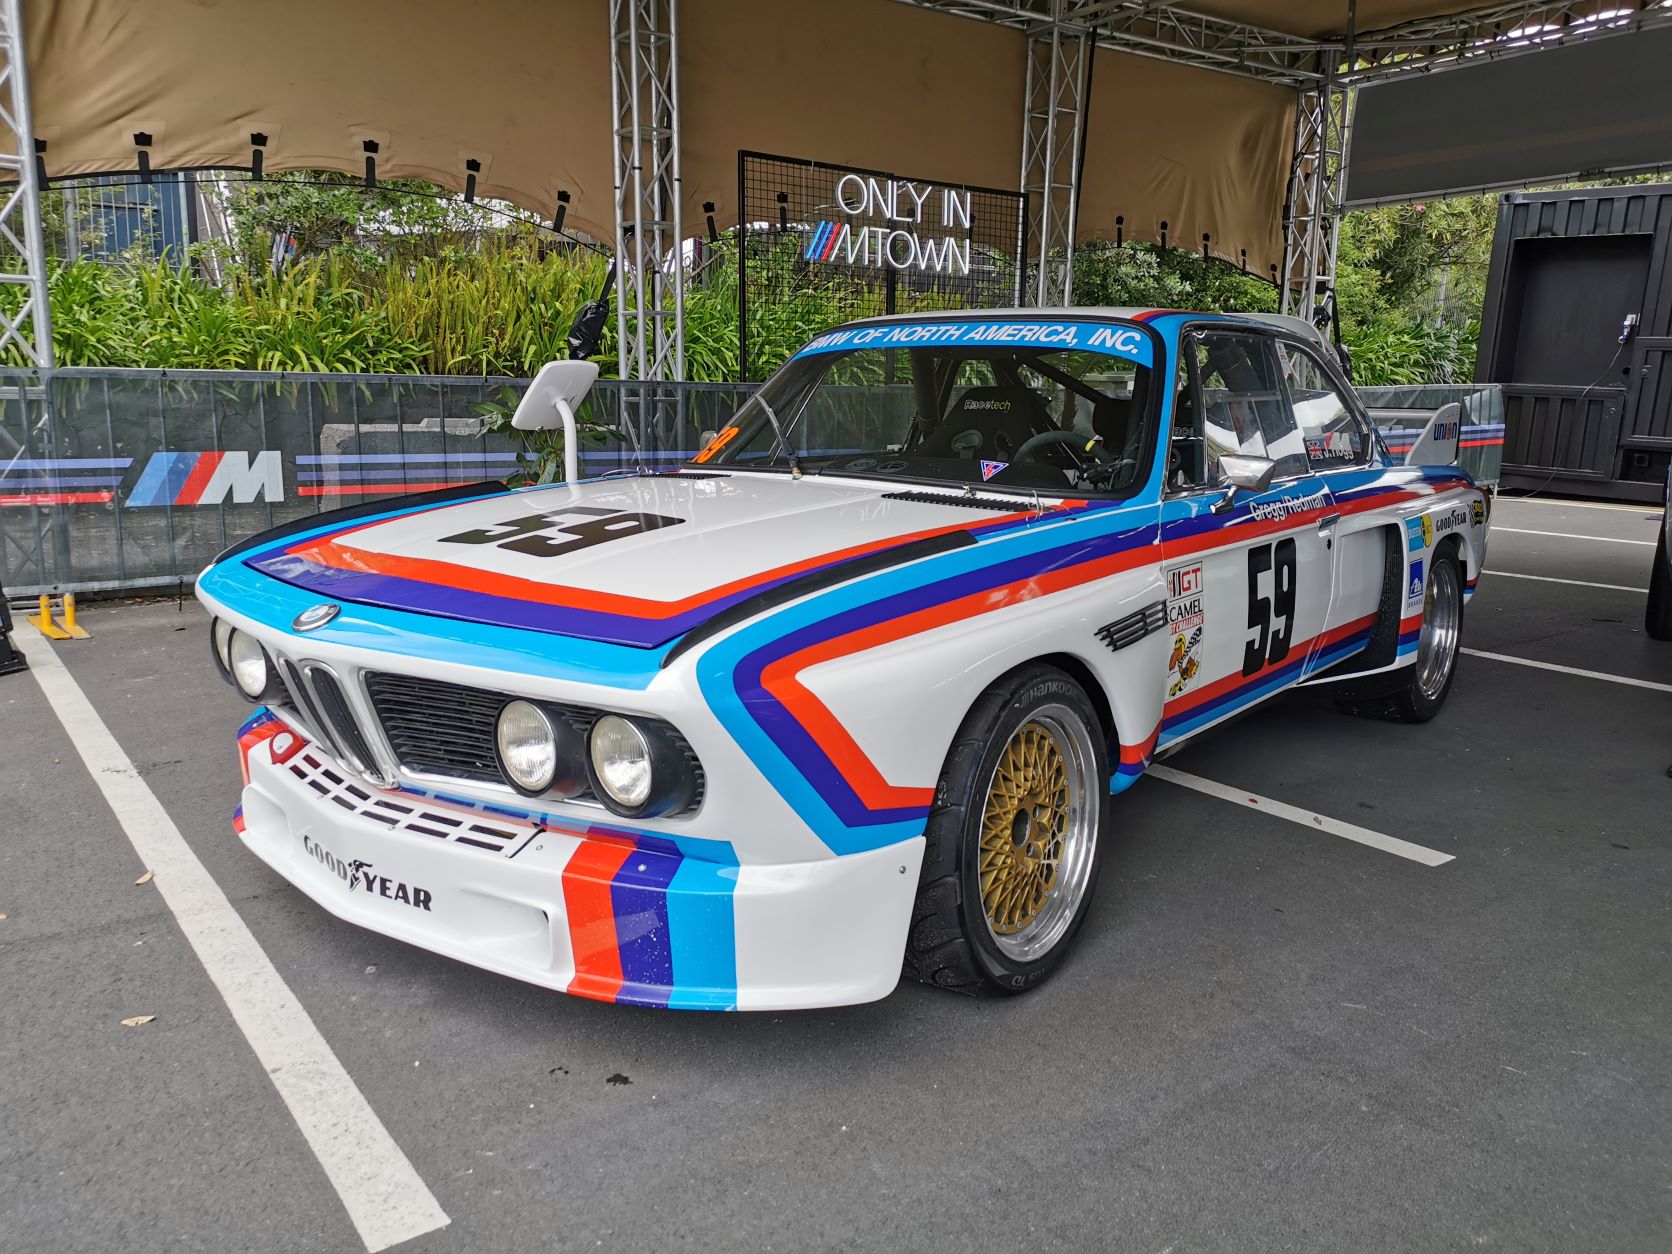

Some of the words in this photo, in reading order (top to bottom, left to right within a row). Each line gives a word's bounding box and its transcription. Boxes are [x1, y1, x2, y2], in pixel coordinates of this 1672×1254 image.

[836, 174, 932, 224] ONLY
[942, 188, 971, 229] IN
[829, 222, 970, 275] MTOWN
[801, 330, 855, 352] BMW
[852, 328, 889, 344] OF
[883, 325, 969, 342] NORTH
[962, 325, 1078, 347] AMERICA,
[1087, 327, 1142, 354] INC.
[963, 400, 1011, 411] Racetech
[437, 506, 686, 558] 59
[1181, 568, 1200, 592] GT
[1169, 598, 1203, 621] CAMEL
[1242, 537, 1297, 678] 59
